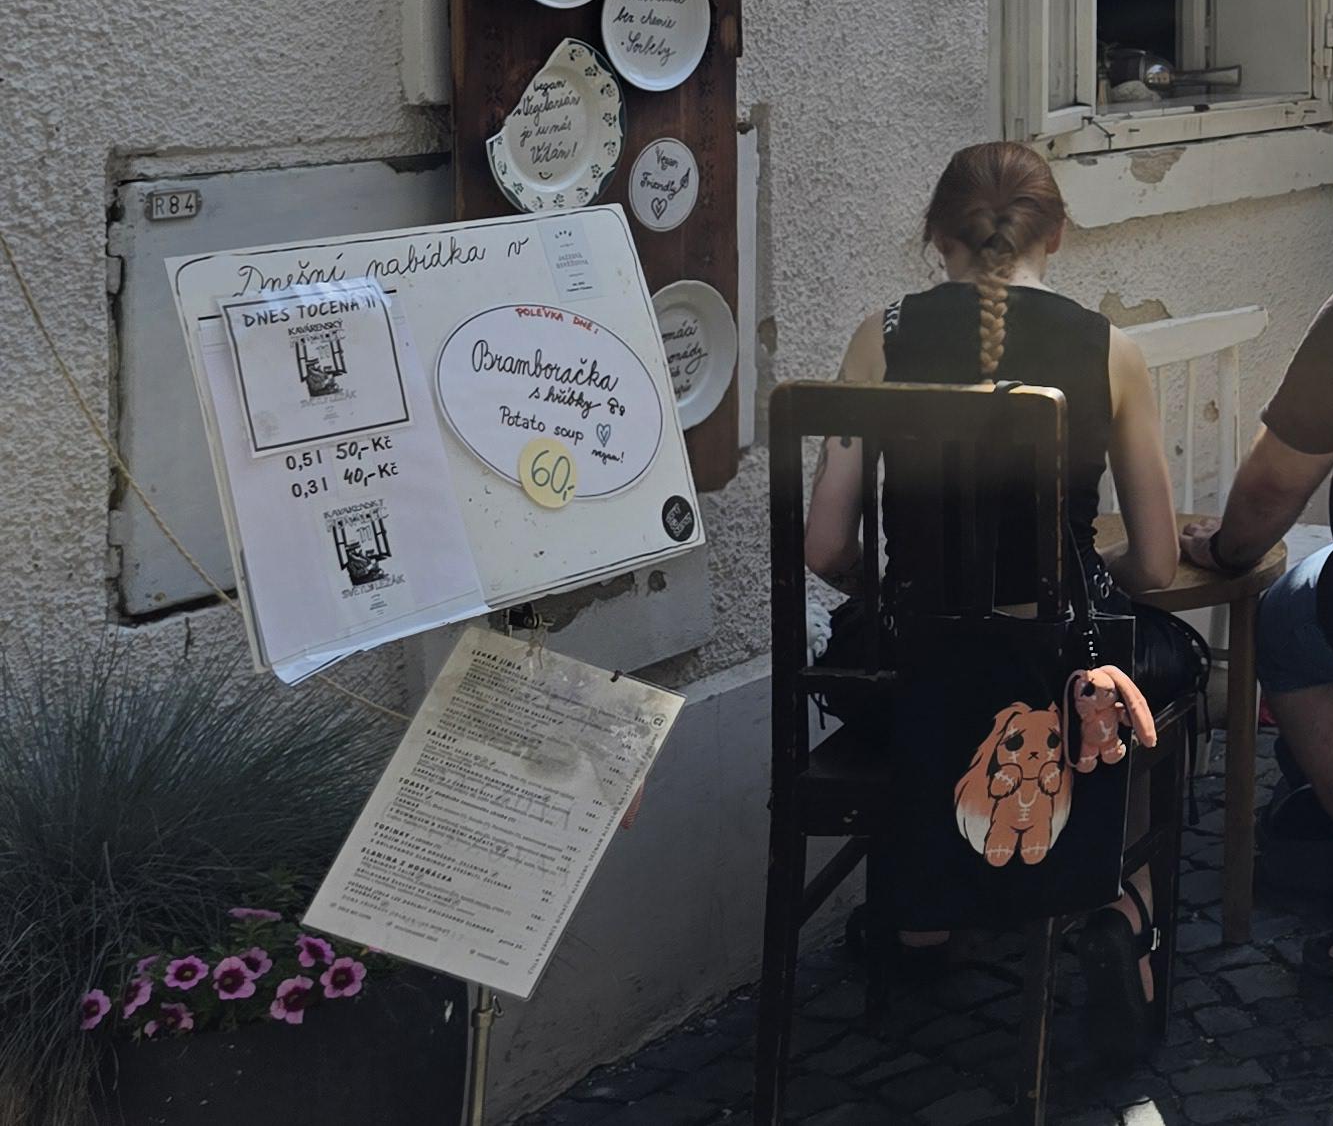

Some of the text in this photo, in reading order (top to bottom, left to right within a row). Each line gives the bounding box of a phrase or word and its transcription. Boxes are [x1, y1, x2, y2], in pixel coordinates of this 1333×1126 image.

[627, 31, 677, 66] Sorbety
[655, 146, 679, 171] Vegan
[640, 171, 677, 200] Friendly
[366, 237, 486, 281] nabídka
[242, 307, 290, 328] DNES
[471, 339, 619, 393] Bramboračka
[528, 385, 602, 419] s hříbky
[499, 405, 584, 446] Potato soup
